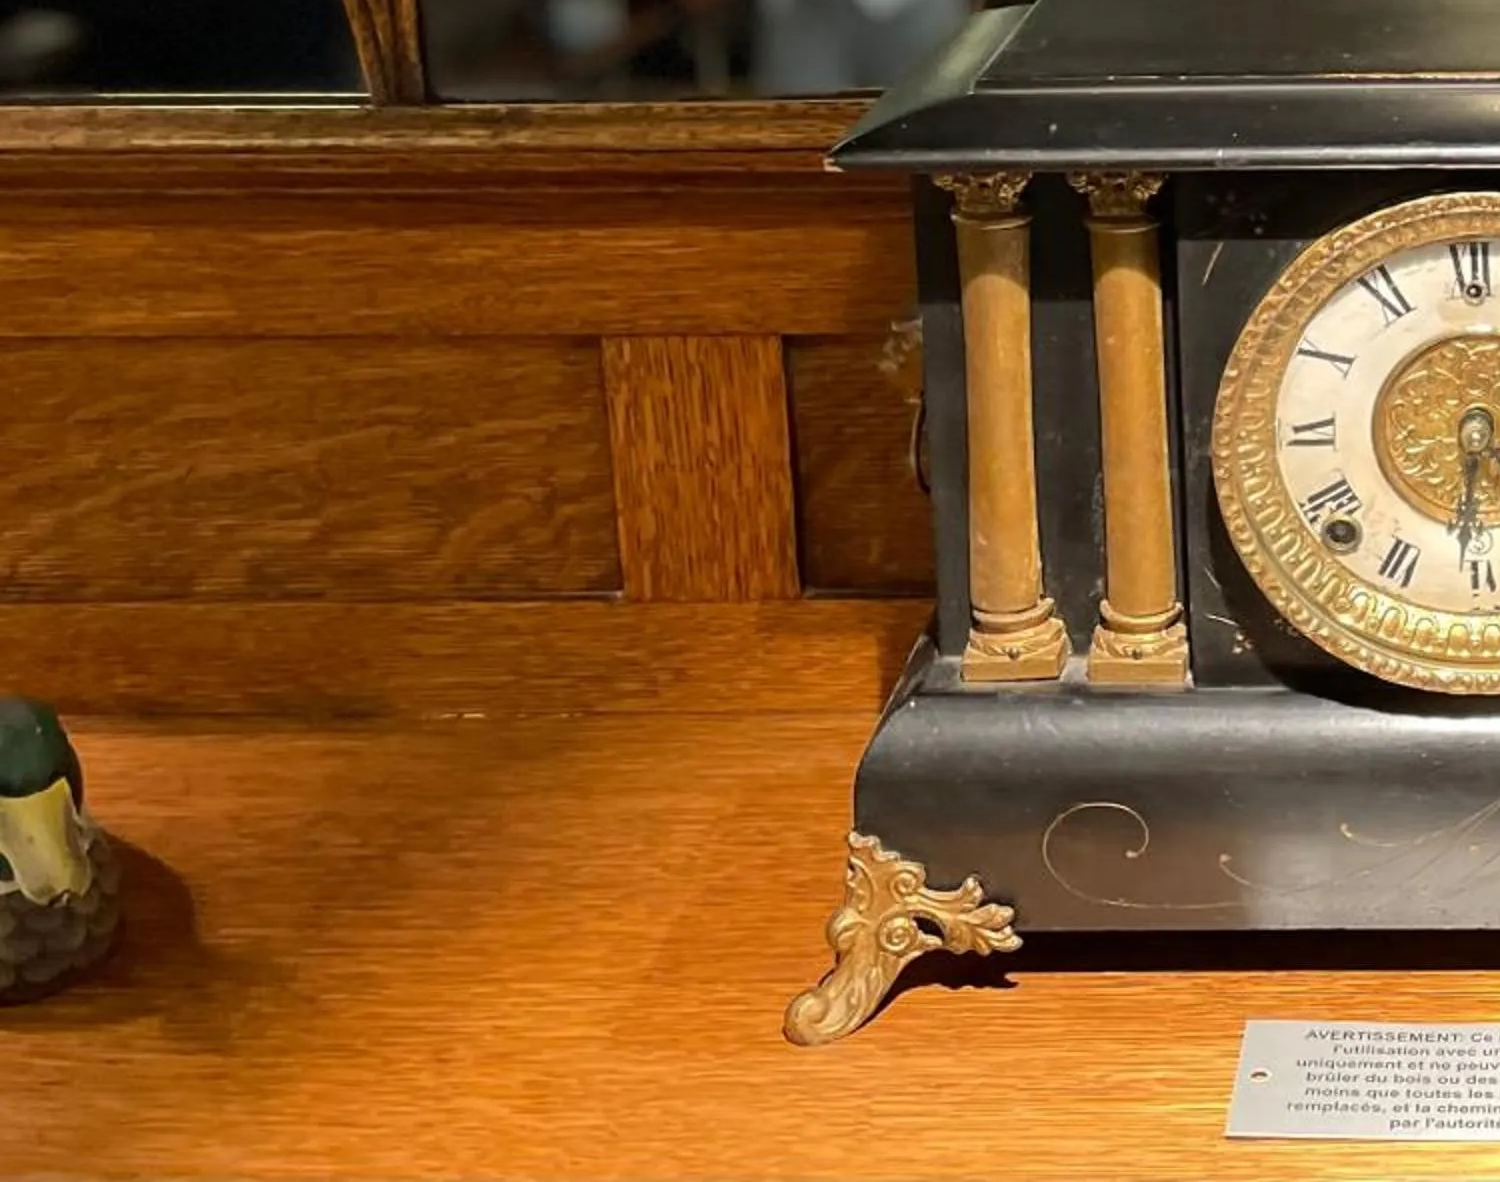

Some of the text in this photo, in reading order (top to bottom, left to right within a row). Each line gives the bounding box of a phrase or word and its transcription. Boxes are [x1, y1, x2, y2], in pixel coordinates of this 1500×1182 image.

[1470, 1033, 1493, 1043] Ce
[1333, 1045, 1430, 1057] l'utilisation
[1435, 1048, 1477, 1057] avec
[1296, 1057, 1402, 1070] uniquement
[1407, 1059, 1424, 1069] et
[1429, 1060, 1451, 1070] ne
[1305, 1071, 1360, 1083] brûler
[1364, 1073, 1388, 1083] du
[1393, 1073, 1431, 1084] bois
[1437, 1075, 1460, 1085] ou
[1466, 1074, 1497, 1085] des
[1305, 1087, 1361, 1098] moins
[1366, 1089, 1399, 1100] que
[1406, 1088, 1462, 1099] toutes
[1468, 1088, 1494, 1099] les
[1286, 1101, 1387, 1114] remplacés,
[1393, 1103, 1410, 1113] et
[1415, 1102, 1431, 1114] la
[1390, 1119, 1419, 1131] par
